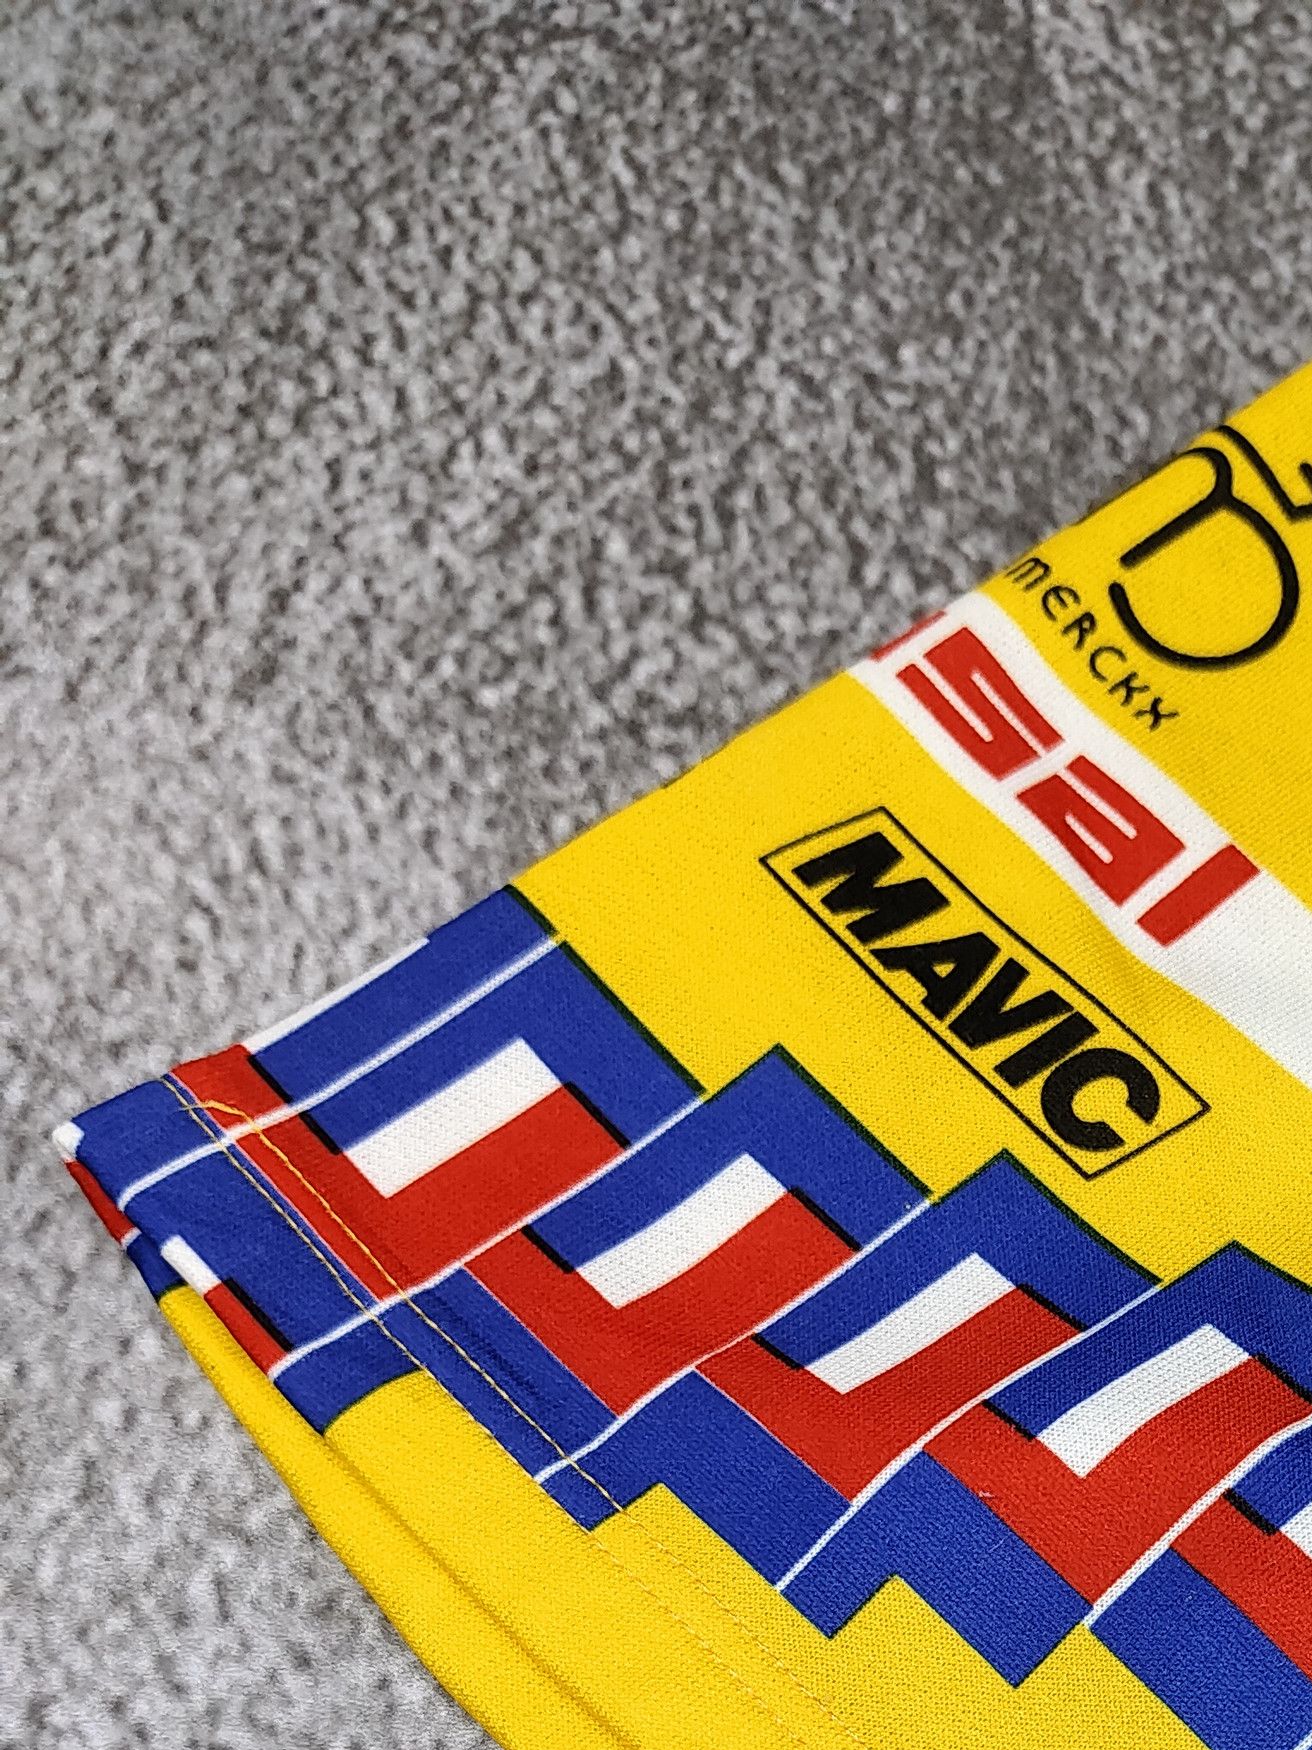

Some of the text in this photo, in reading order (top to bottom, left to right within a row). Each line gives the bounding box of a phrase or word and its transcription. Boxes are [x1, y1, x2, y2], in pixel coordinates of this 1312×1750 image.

[870, 610, 1261, 948] sal
[1004, 557, 1179, 731] MERCKX
[792, 831, 1161, 1153] MAVIC
